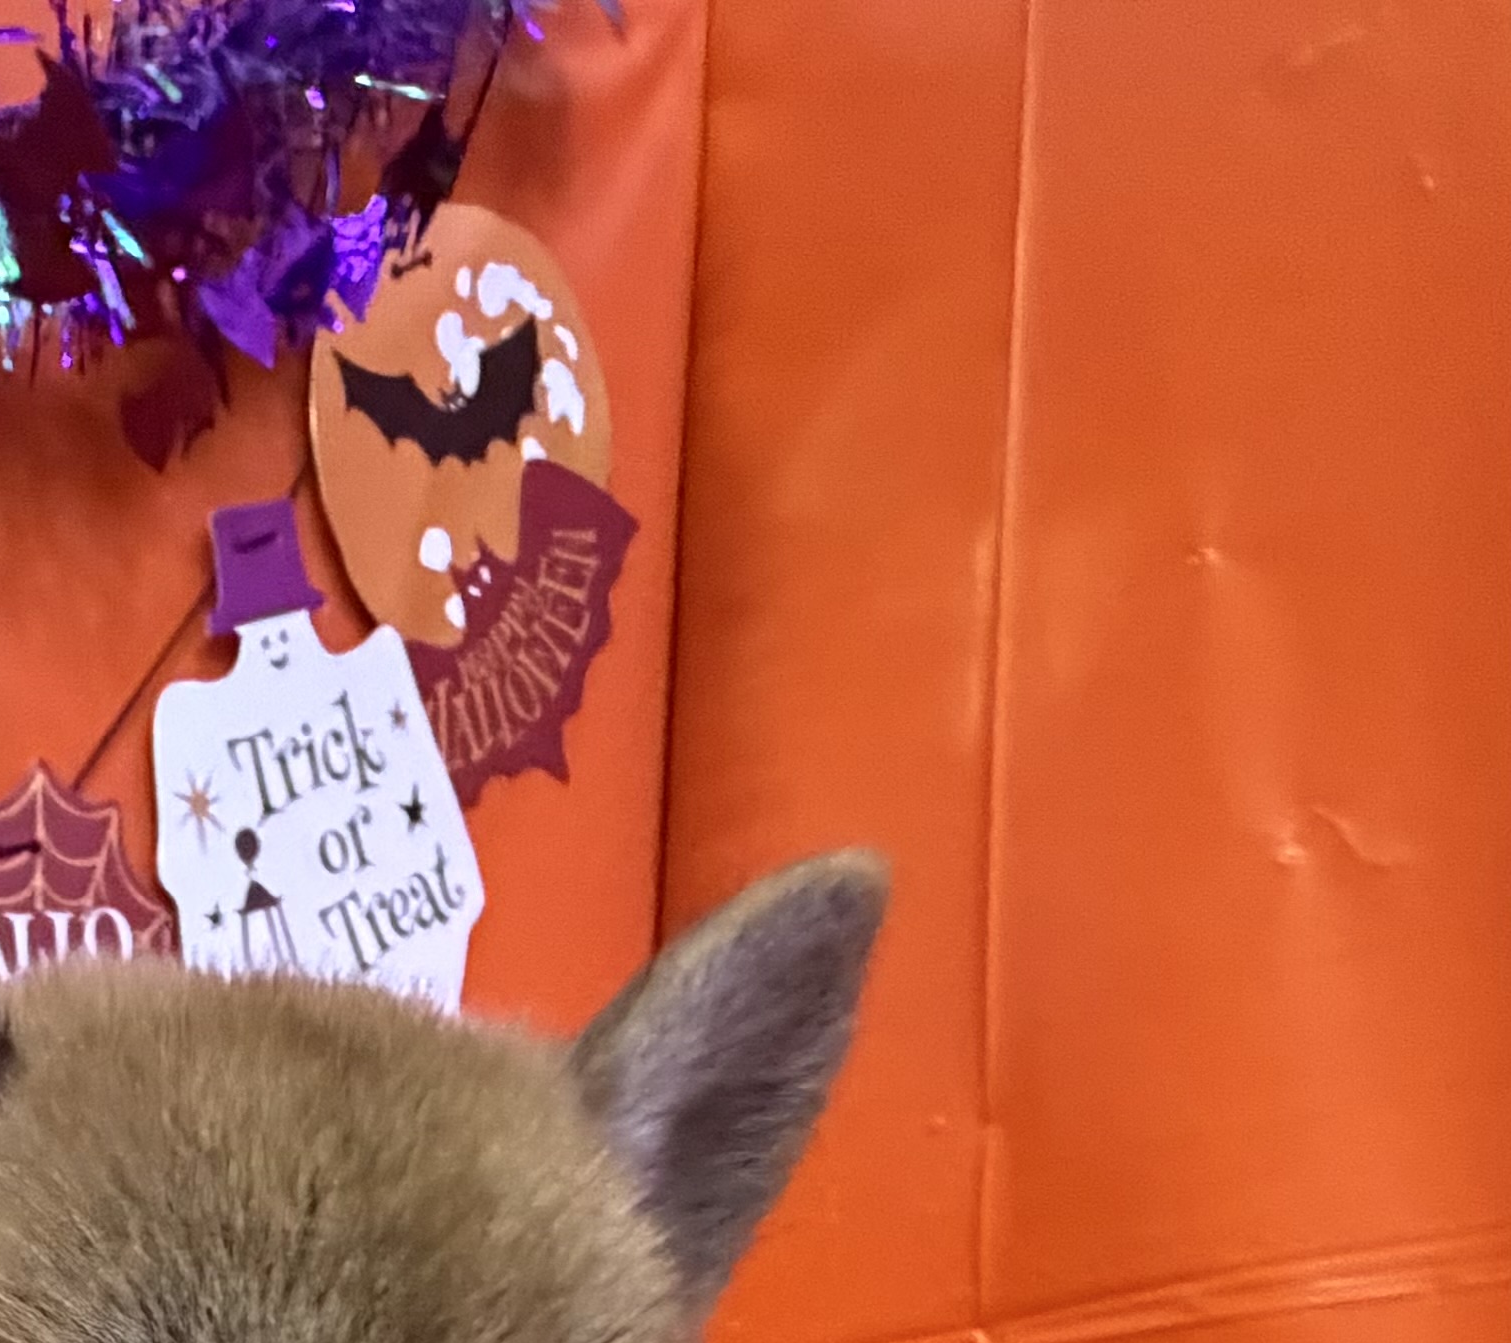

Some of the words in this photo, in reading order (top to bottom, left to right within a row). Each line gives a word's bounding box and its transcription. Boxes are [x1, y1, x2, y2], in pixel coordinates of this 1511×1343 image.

[227, 690, 386, 827] Trick
[318, 804, 375, 874] or
[318, 843, 465, 972] Treat
